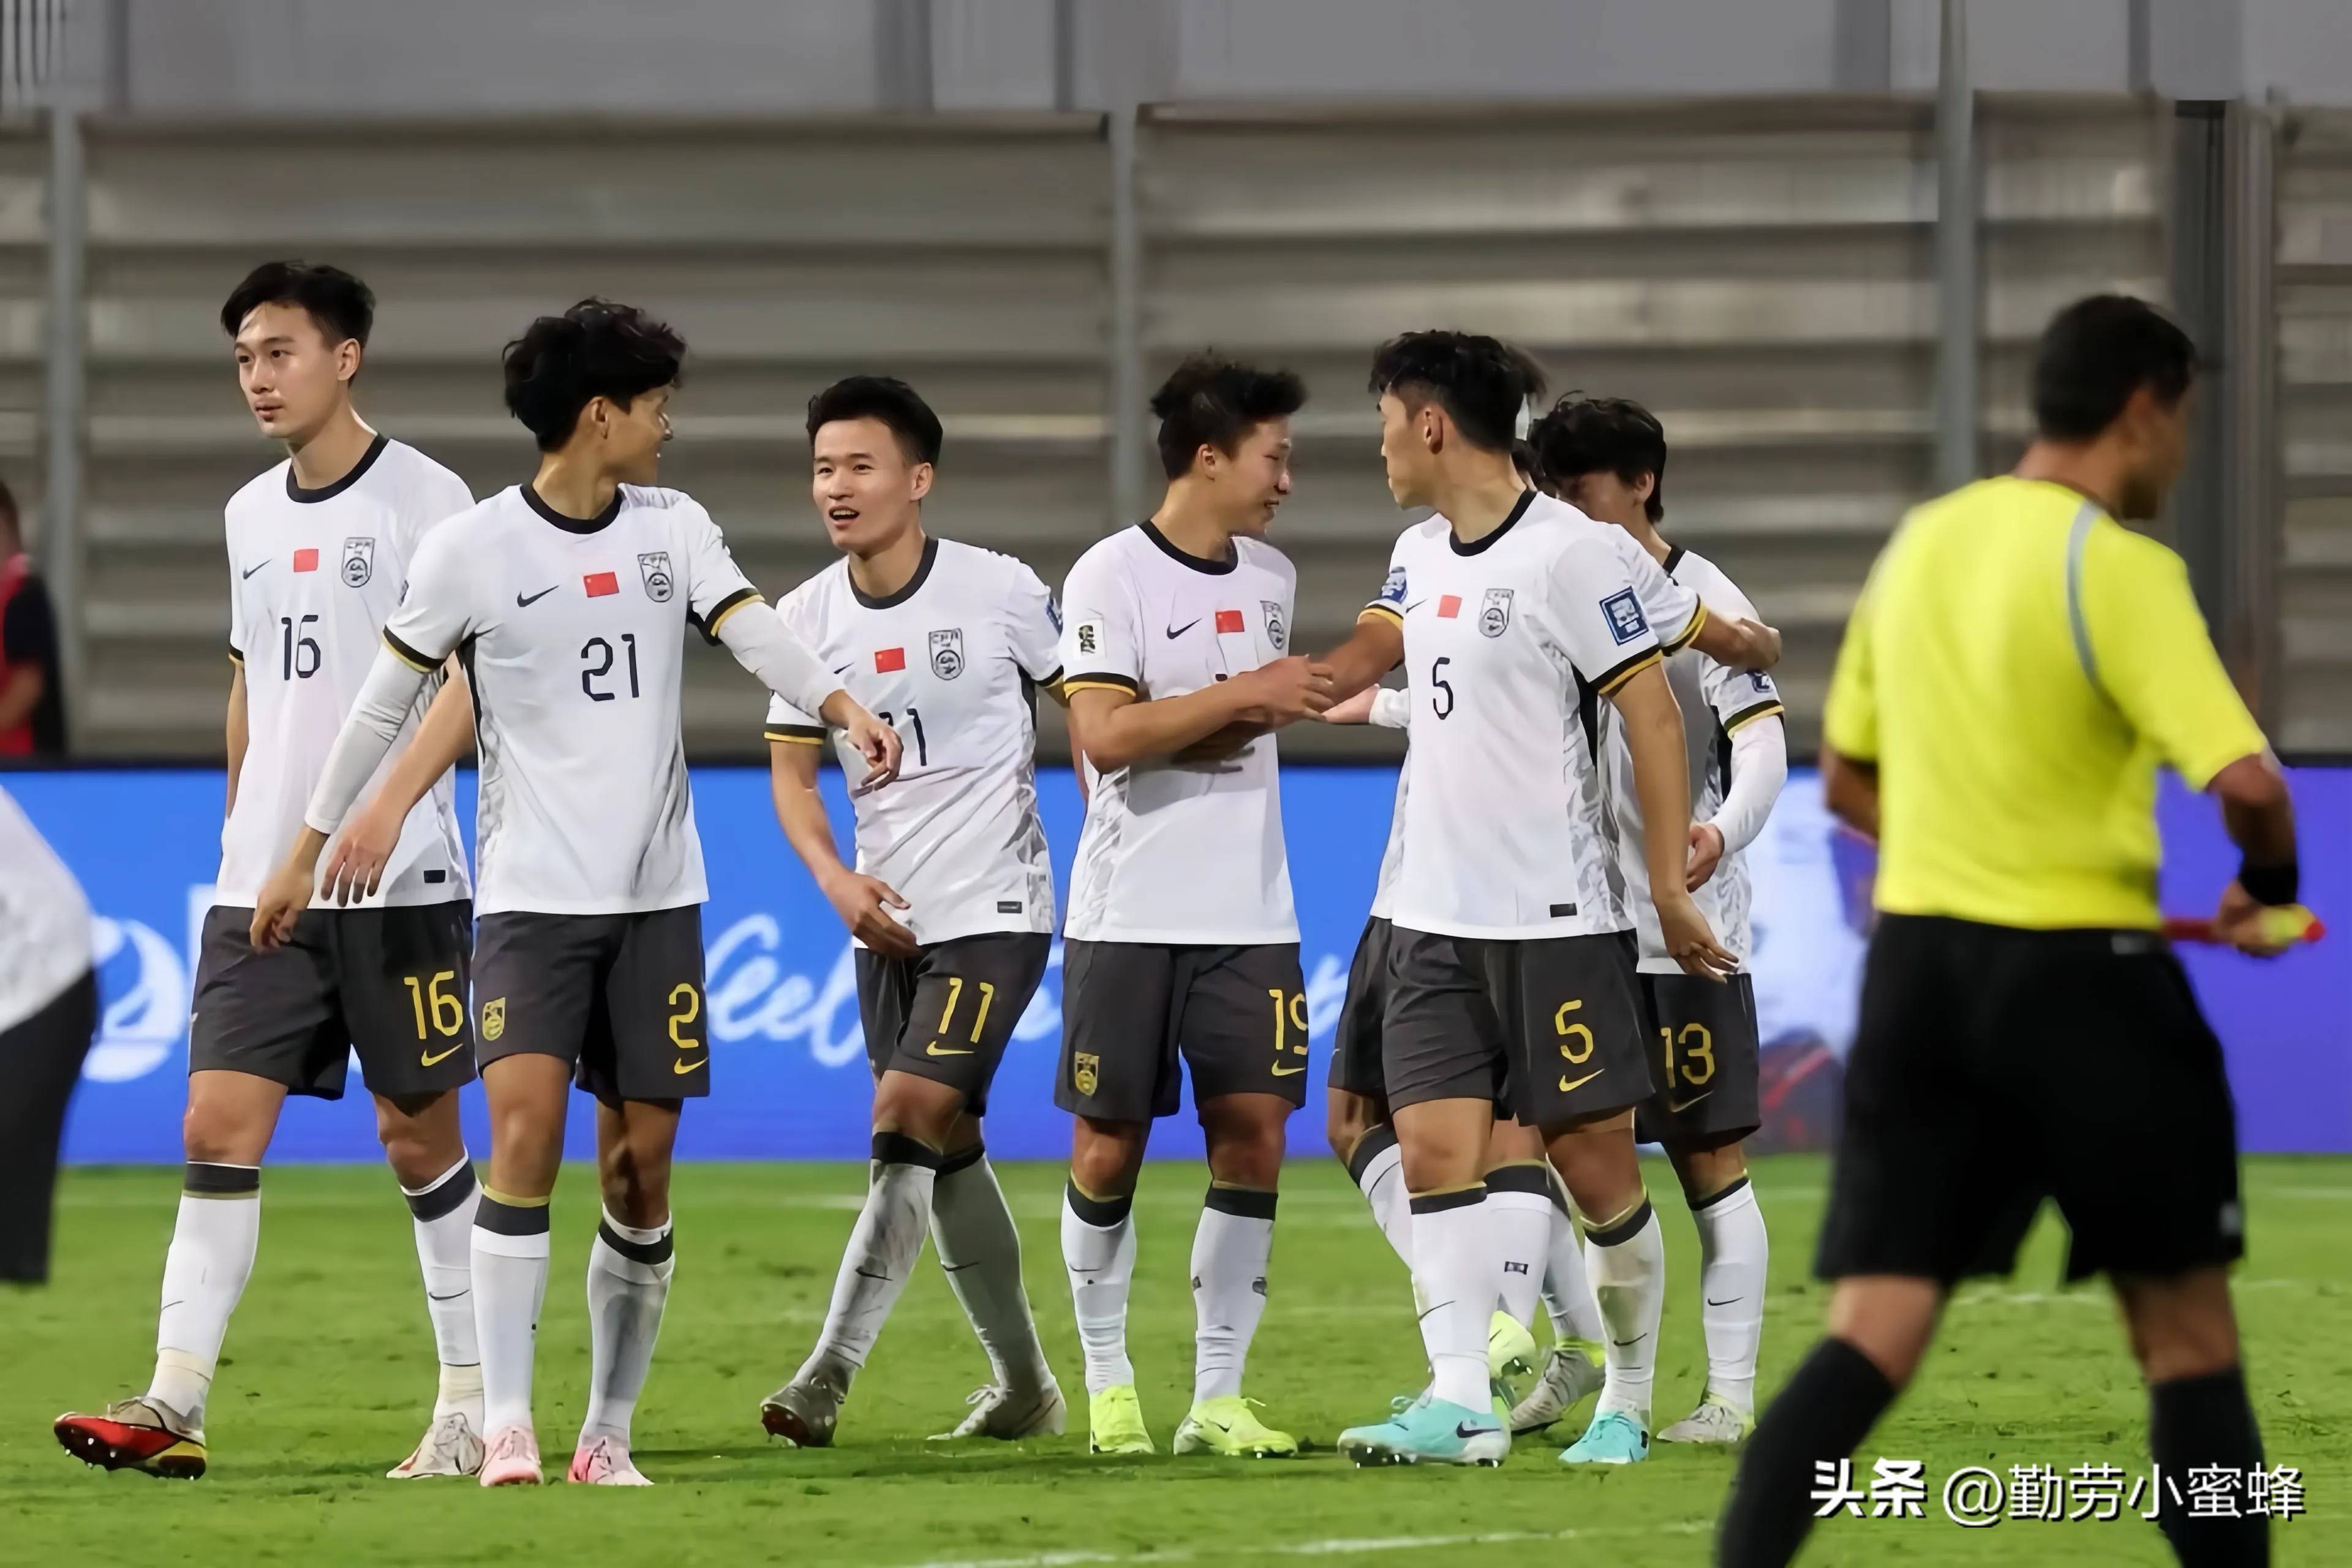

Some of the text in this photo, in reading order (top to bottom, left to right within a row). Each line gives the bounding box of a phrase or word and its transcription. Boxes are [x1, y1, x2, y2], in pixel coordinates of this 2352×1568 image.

[281, 614, 321, 680] 16
[581, 633, 639, 701] 21
[1432, 657, 1453, 720] 5
[878, 708, 927, 766] 1
[404, 971, 464, 1040] 16
[937, 977, 994, 1044] 11
[1554, 999, 1594, 1064] 5
[1660, 1023, 1716, 1088] 13
